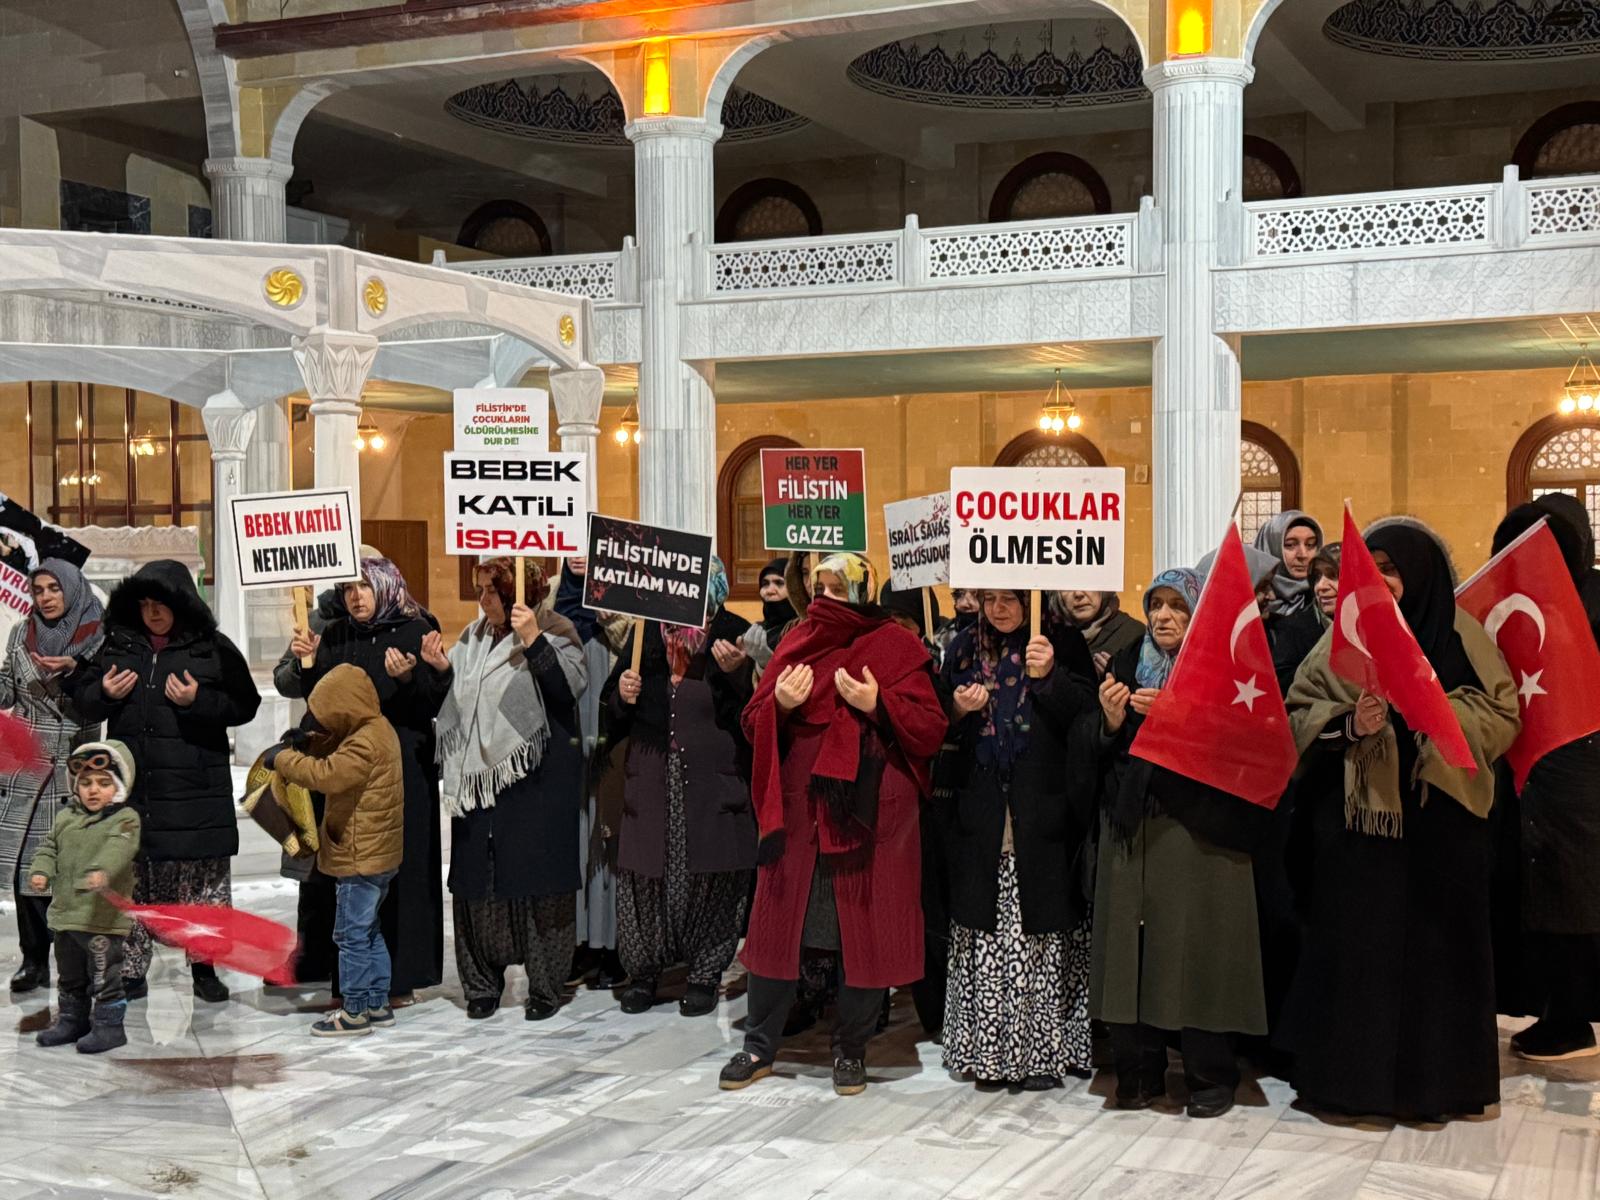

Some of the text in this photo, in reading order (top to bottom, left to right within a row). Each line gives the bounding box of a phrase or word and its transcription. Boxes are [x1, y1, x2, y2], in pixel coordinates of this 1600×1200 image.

[464, 425, 539, 435] ÖLDÜRÜLMESİNE
[472, 415, 530, 424] ÇOCUKLARIN
[484, 437, 519, 445] DUR DE!
[451, 460, 581, 482] BEBEK
[785, 456, 838, 471] HER YER
[778, 475, 848, 500] FİLİSTİN
[788, 504, 840, 519] HER YER
[956, 491, 1120, 527] ÇOCUKLAR
[244, 503, 342, 539] BEBEK KATİLİ
[457, 522, 578, 551] İSRAİL
[786, 524, 844, 545] GAZZE
[252, 542, 342, 574] NETANYAHU.
[969, 527, 1105, 566] ÖLMESİN
[594, 566, 700, 599] KATLİAM VAR
